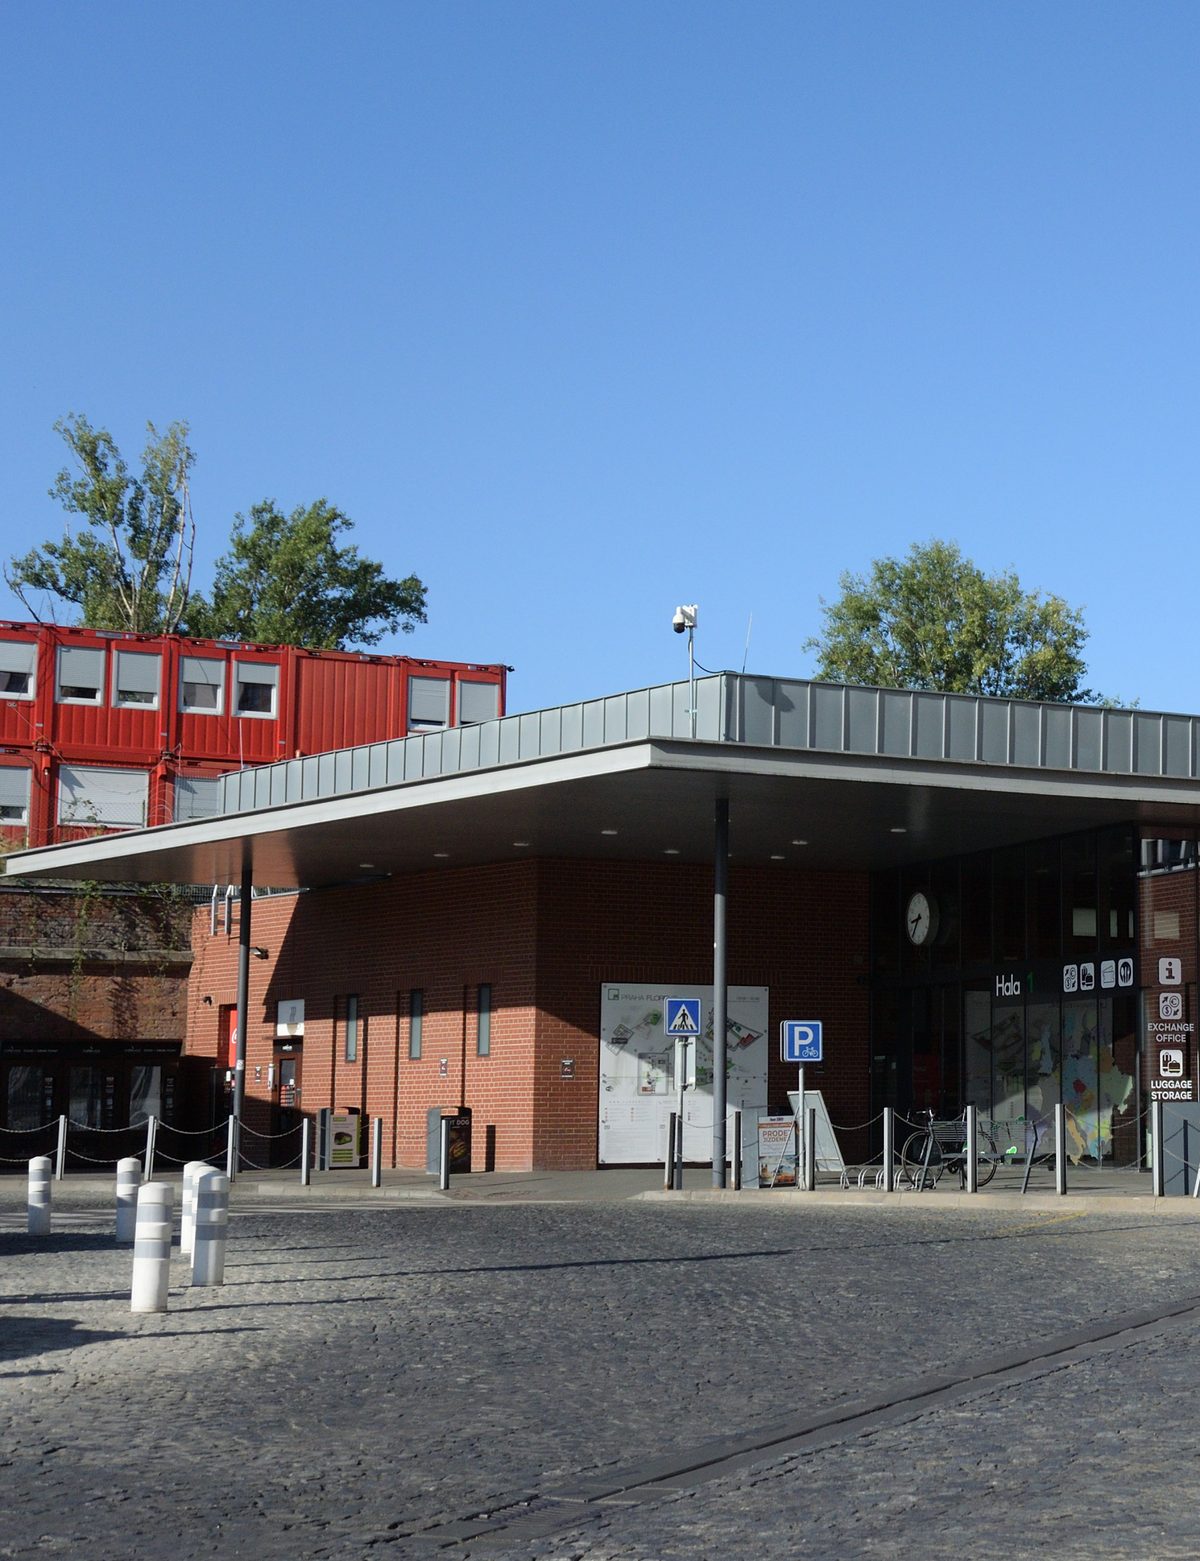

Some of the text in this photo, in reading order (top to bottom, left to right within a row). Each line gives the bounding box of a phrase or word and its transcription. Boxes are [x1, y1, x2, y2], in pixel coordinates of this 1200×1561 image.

[996, 973, 1021, 997] Hala
[1147, 1023, 1195, 1032] EXCHANGE
[794, 1026, 813, 1057] P
[1156, 1034, 1187, 1043] OFFICE
[1151, 1080, 1193, 1089] LUGGAGE
[1151, 1091, 1193, 1100] STORAGE
